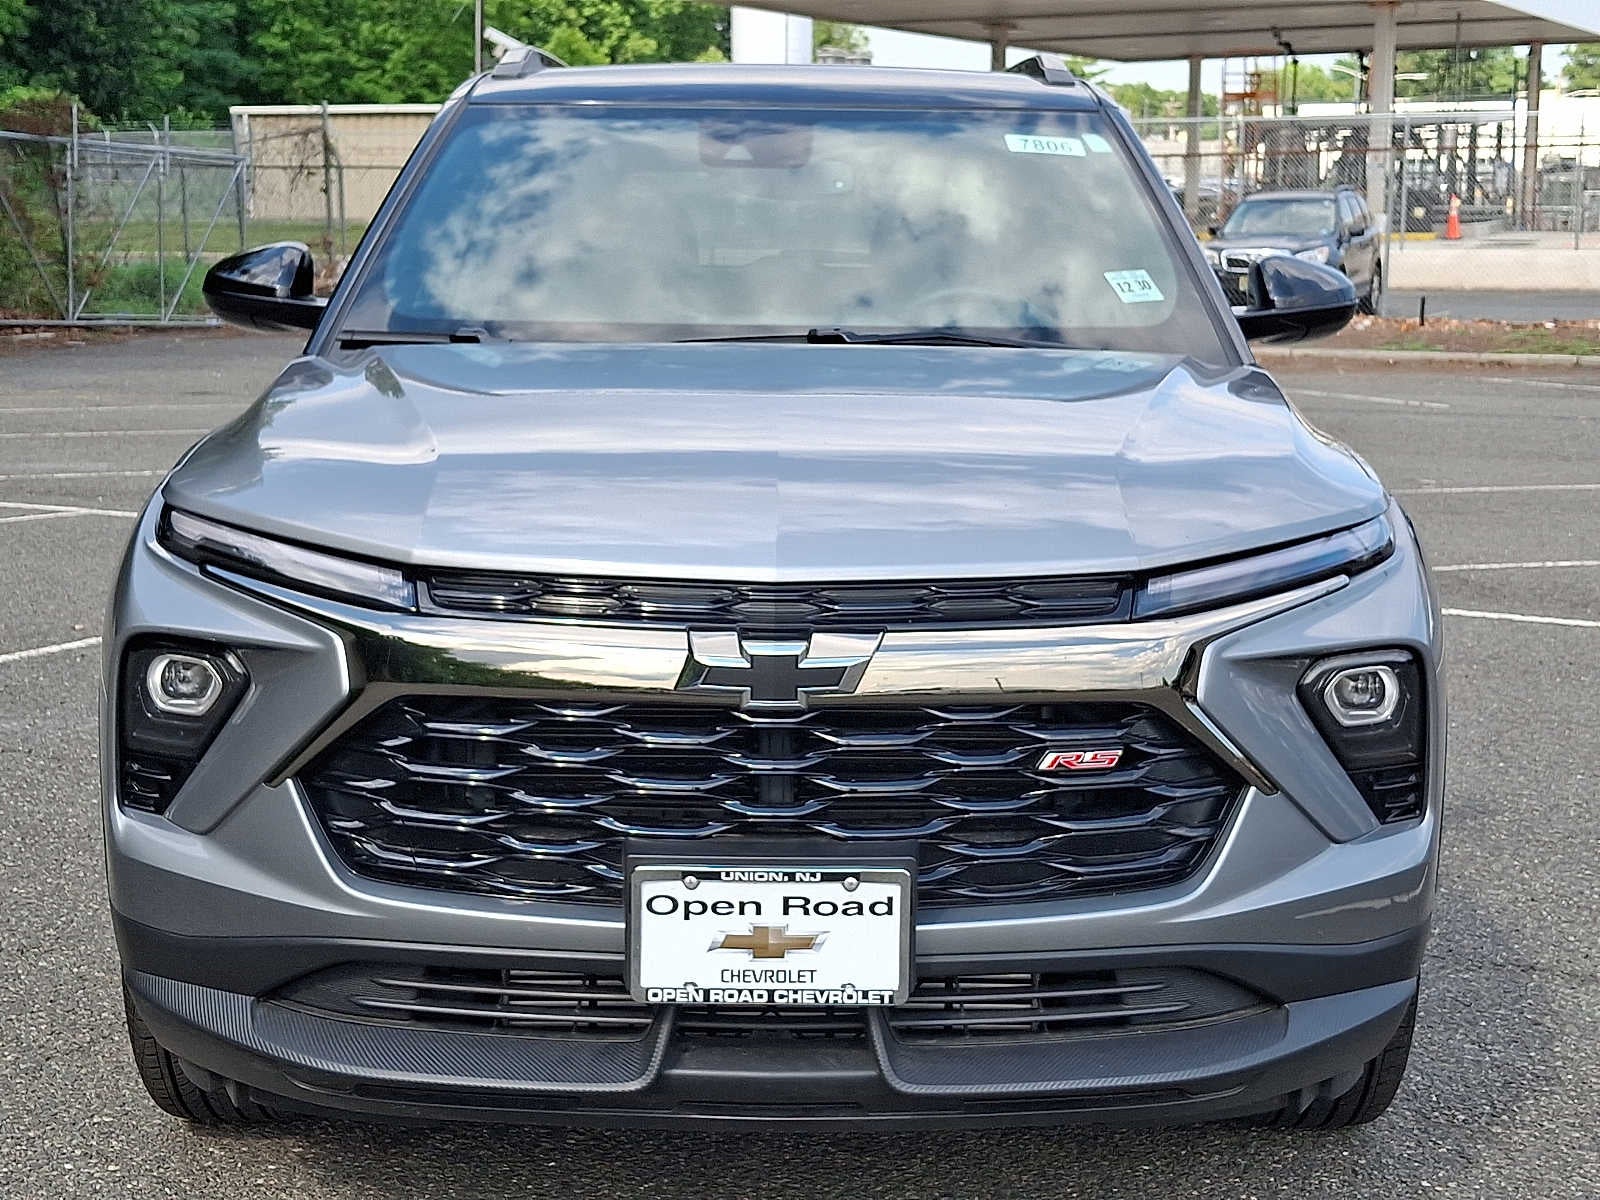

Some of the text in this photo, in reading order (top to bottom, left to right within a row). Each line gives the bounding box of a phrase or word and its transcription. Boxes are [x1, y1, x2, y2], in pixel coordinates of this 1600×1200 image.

[1019, 139, 1073, 153] 7806
[1116, 281, 1135, 293] 12
[1038, 749, 1123, 770] RS
[721, 871, 822, 883] UNION, NJ
[646, 895, 894, 921] Open Road
[720, 969, 817, 984] CHEVROLET
[647, 988, 894, 1004] OPEN ROAD CHEVROLET
